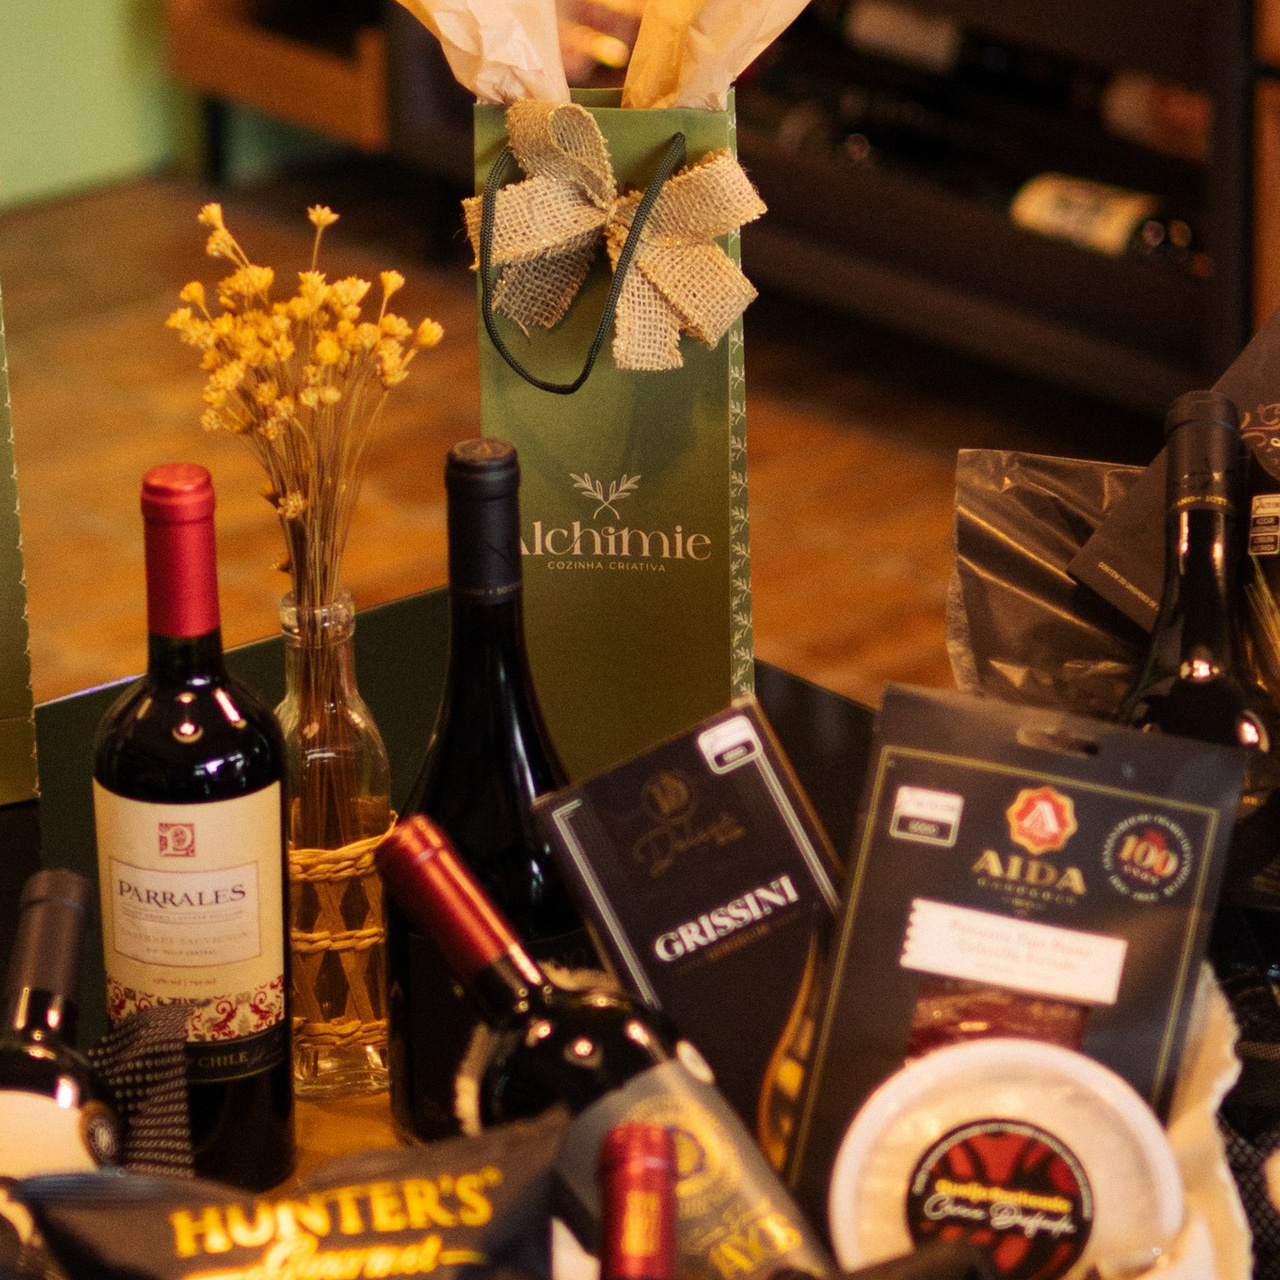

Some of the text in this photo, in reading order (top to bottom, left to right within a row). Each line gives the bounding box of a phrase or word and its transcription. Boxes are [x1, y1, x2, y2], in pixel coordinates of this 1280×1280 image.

[547, 560, 666, 572] COZINHA CRIATIVA
[972, 849, 1087, 896] AIDA
[119, 880, 246, 909] PARRALES
[655, 875, 799, 961] GRISSINI
[198, 1052, 248, 1068] CHILE
[171, 1173, 494, 1258] HUNTER'S
